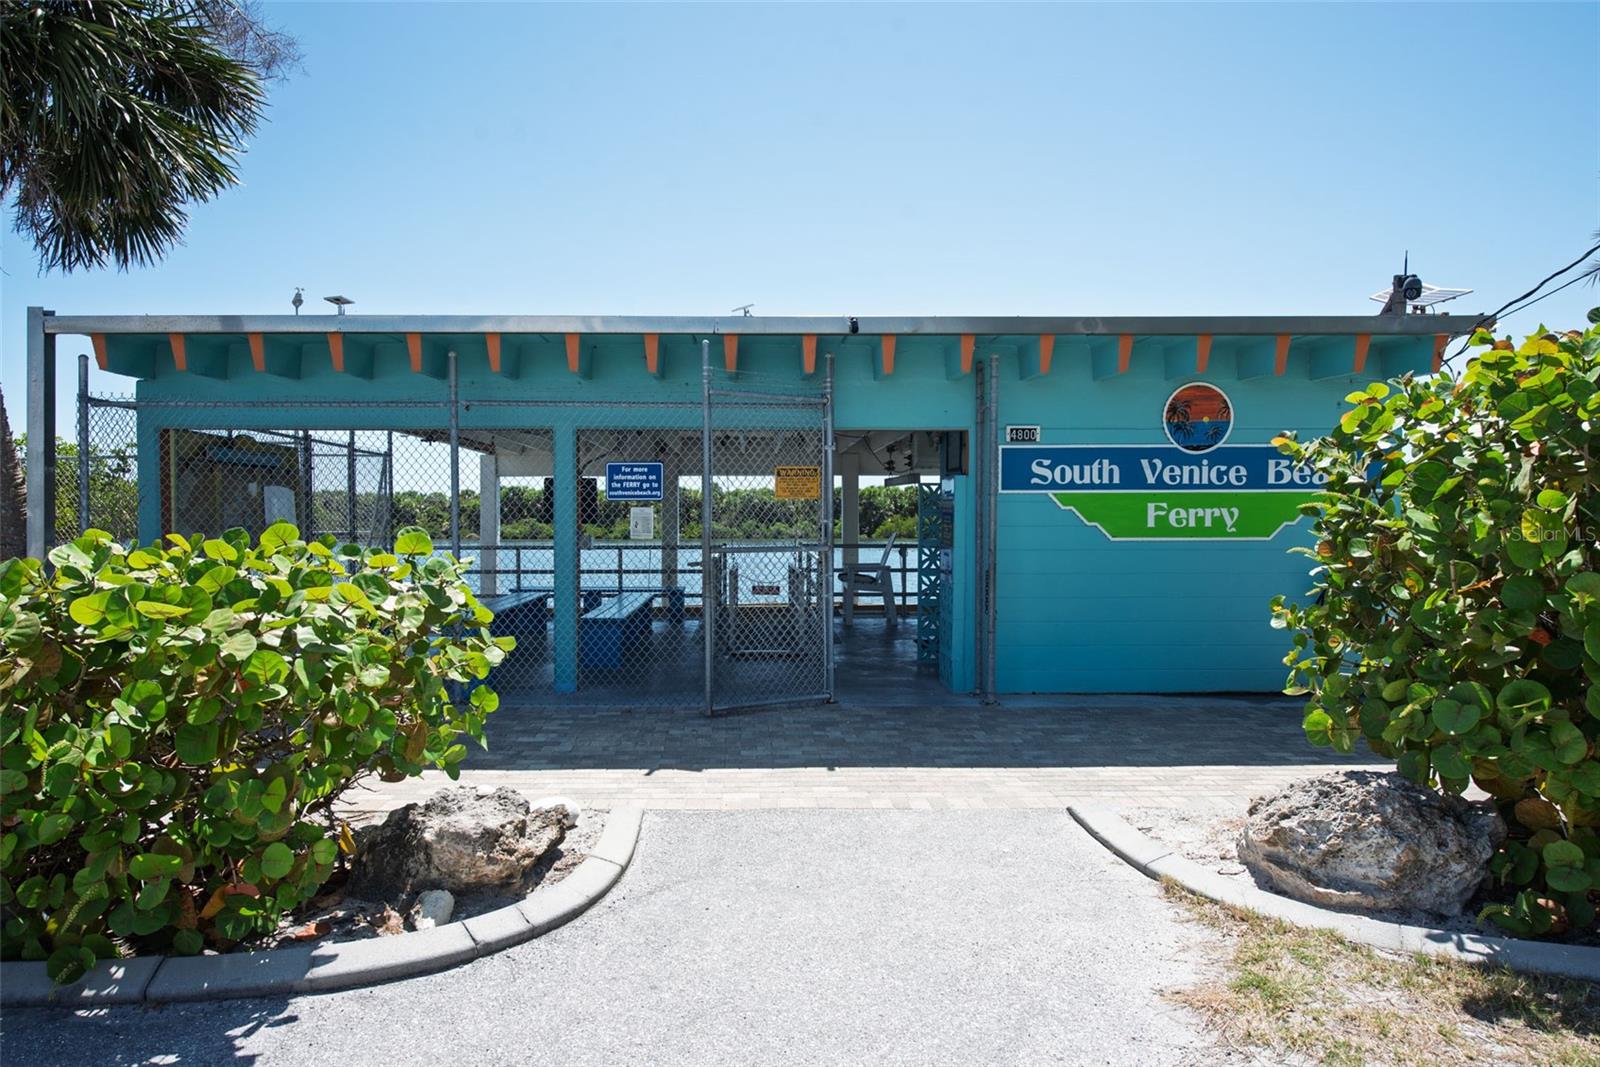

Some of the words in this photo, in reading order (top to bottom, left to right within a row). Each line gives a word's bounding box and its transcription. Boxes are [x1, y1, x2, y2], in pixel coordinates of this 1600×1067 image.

[1011, 430, 1036, 440] 4800
[1030, 458, 1121, 485] South
[1140, 458, 1248, 485] Venice
[1267, 459, 1330, 485] Bea
[1147, 502, 1240, 532] Ferry
